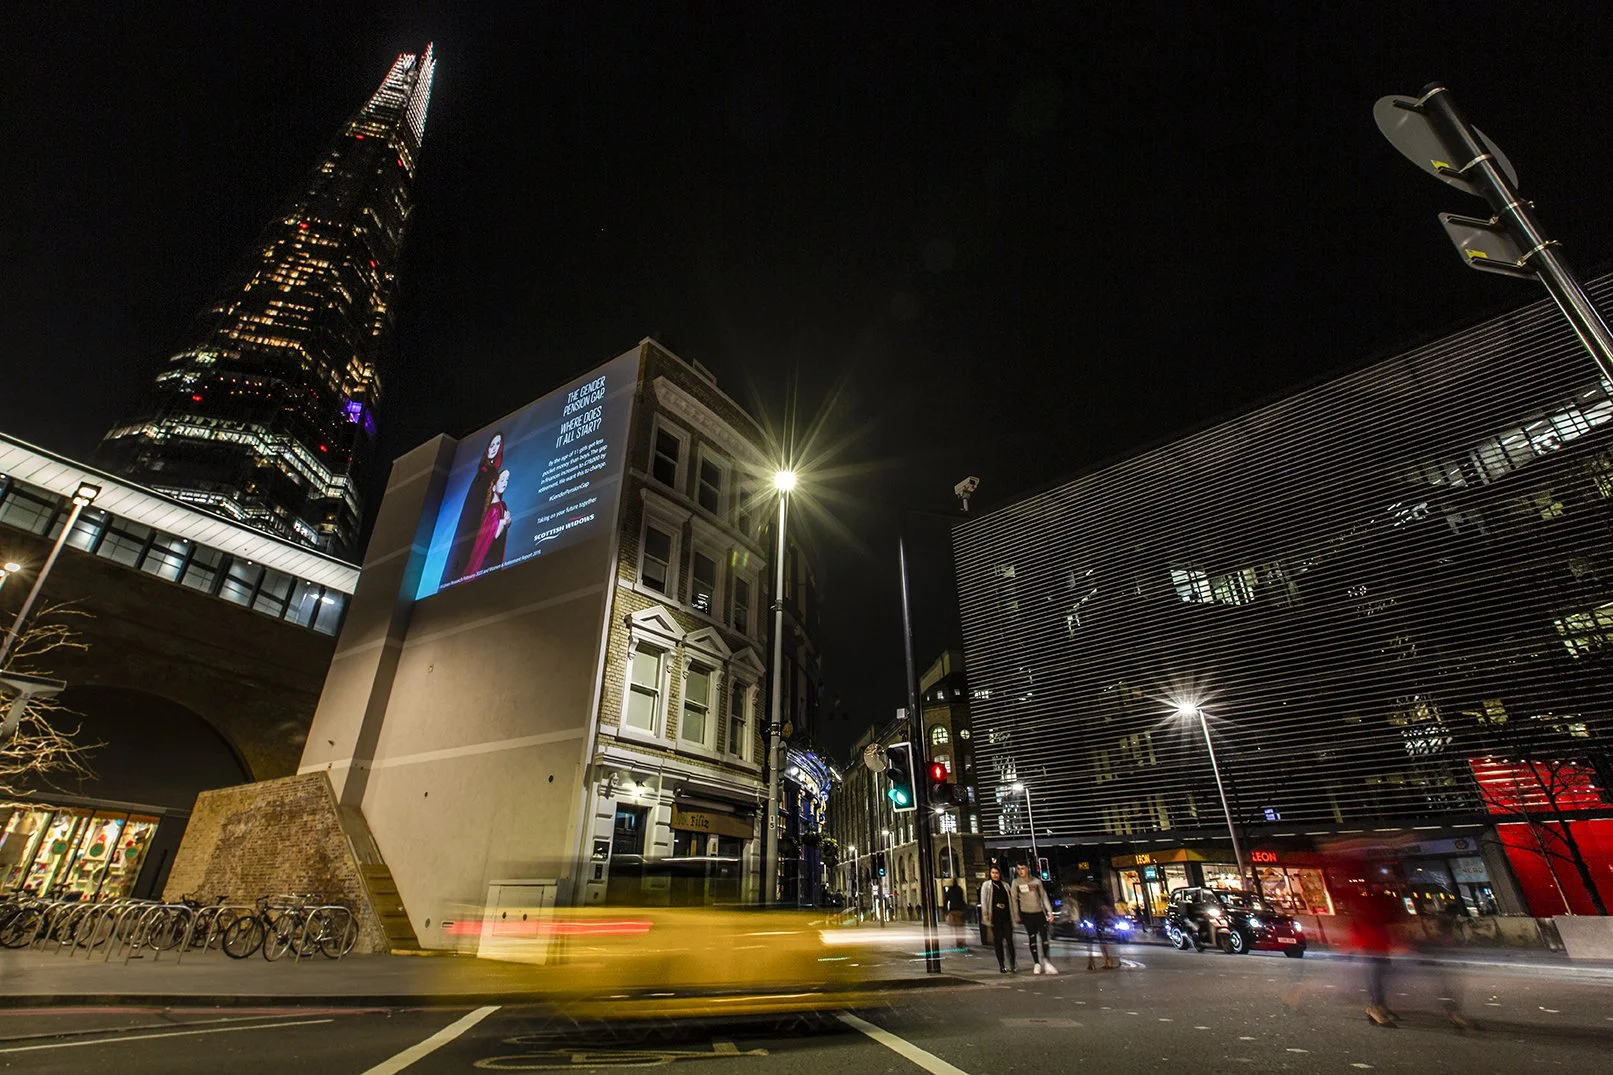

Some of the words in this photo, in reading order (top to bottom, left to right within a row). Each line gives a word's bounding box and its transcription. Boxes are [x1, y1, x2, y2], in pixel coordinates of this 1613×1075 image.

[568, 389, 580, 404] THE
[580, 376, 606, 397] GENDER
[563, 396, 590, 417] PENSION
[560, 414, 583, 434] WHERE
[584, 406, 602, 424] DOES
[556, 436, 563, 448] IT
[563, 430, 574, 445] ALL
[576, 418, 602, 439] START?
[542, 467, 556, 478] pocket
[556, 461, 570, 470] money
[599, 445, 608, 453] gap
[566, 474, 577, 482] want
[549, 482, 590, 501] #GenderPensionGap
[537, 515, 550, 524] Taking
[556, 510, 566, 518] your
[566, 504, 579, 513] future
[534, 525, 564, 541] SCOTTISH
[565, 514, 594, 529] WIDOWS
[1136, 854, 1150, 864] LEON
[1251, 851, 1277, 862] LEON
